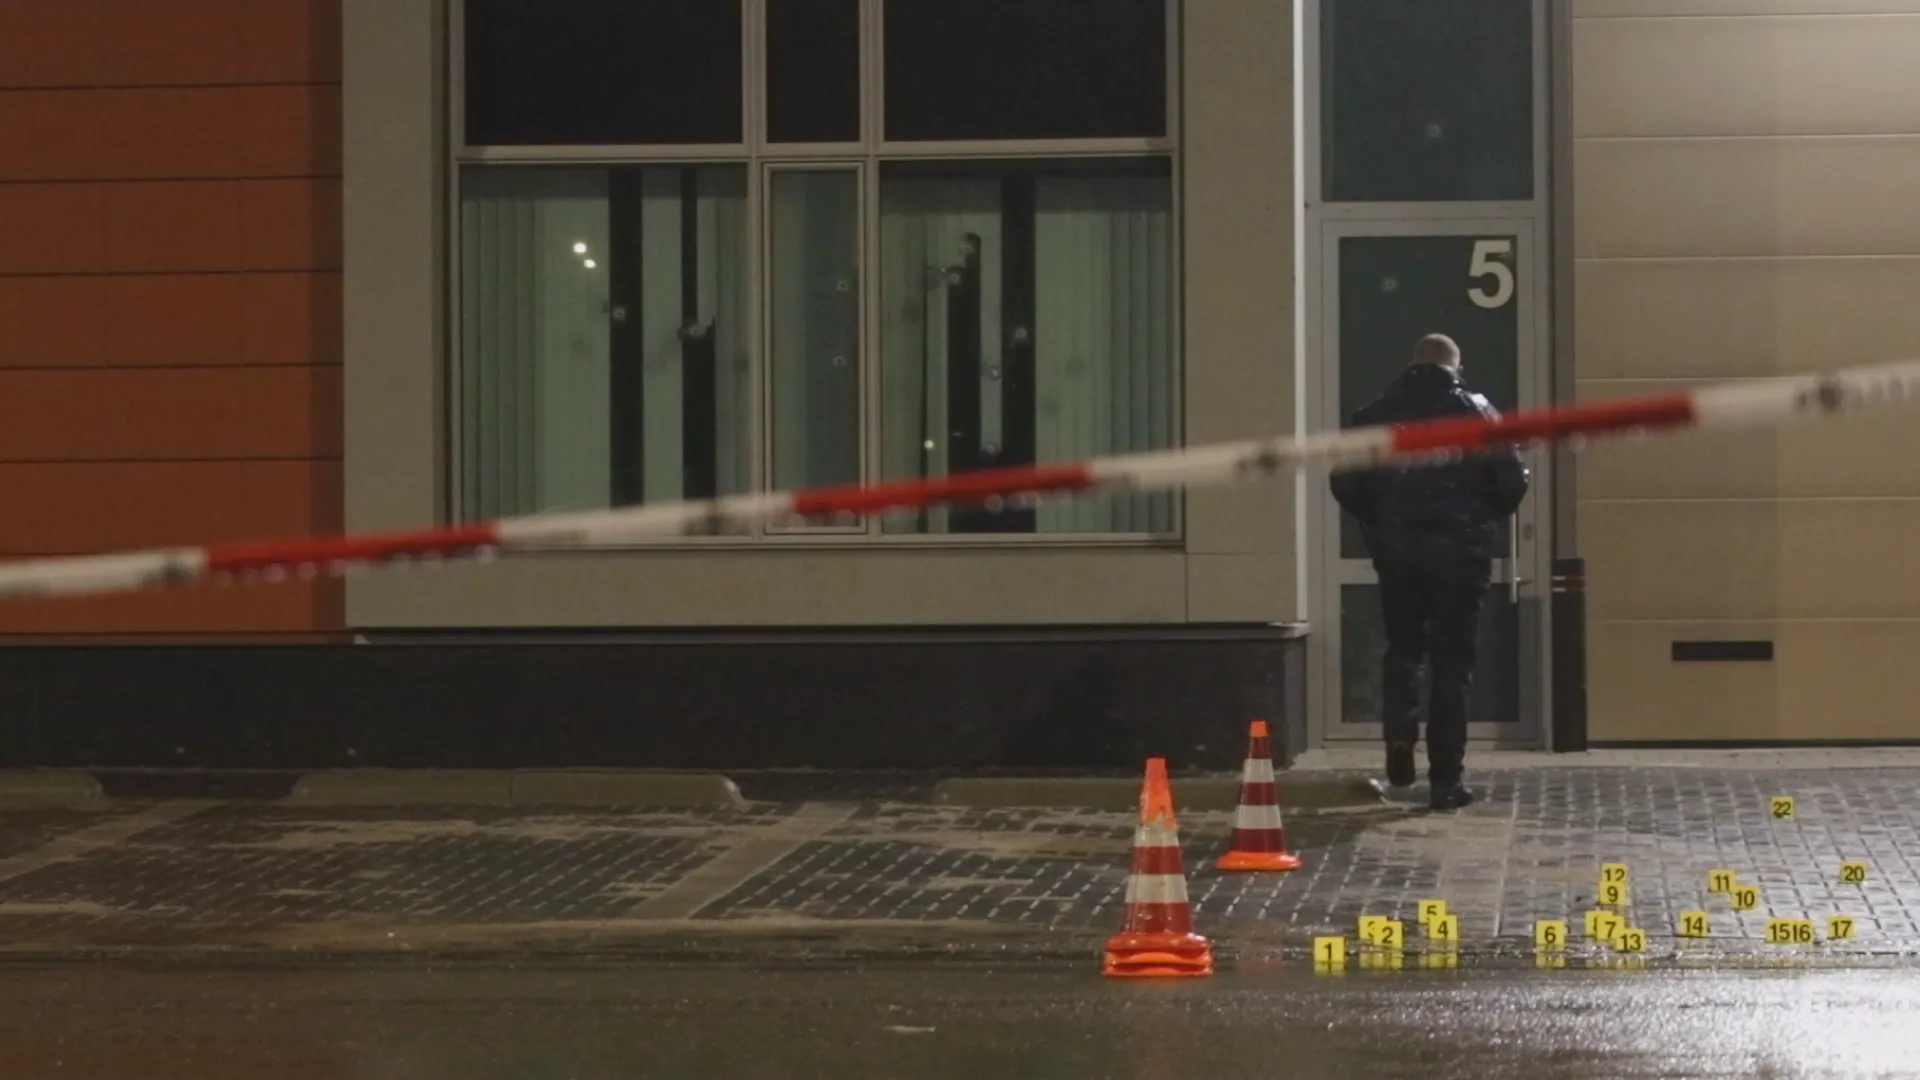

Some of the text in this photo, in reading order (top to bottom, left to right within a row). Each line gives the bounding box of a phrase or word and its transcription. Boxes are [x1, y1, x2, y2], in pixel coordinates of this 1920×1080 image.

[1467, 240, 1514, 308] 5
[1773, 801, 1792, 817] 22
[1604, 868, 1625, 882] 12
[1714, 874, 1730, 891] 11
[1844, 866, 1864, 882] 20
[1607, 886, 1618, 902] 9
[1736, 890, 1755, 907] 10
[1426, 905, 1437, 919] 5
[1437, 920, 1448, 937] 4
[1605, 921, 1616, 939] 7
[1684, 916, 1703, 934] 14
[1769, 923, 1791, 940] 15
[1793, 923, 1811, 940] 16
[1831, 920, 1852, 938] 17
[1382, 926, 1394, 944] 2
[1544, 926, 1556, 944] 6
[1620, 933, 1641, 951] 13
[1324, 942, 1333, 960] 1
